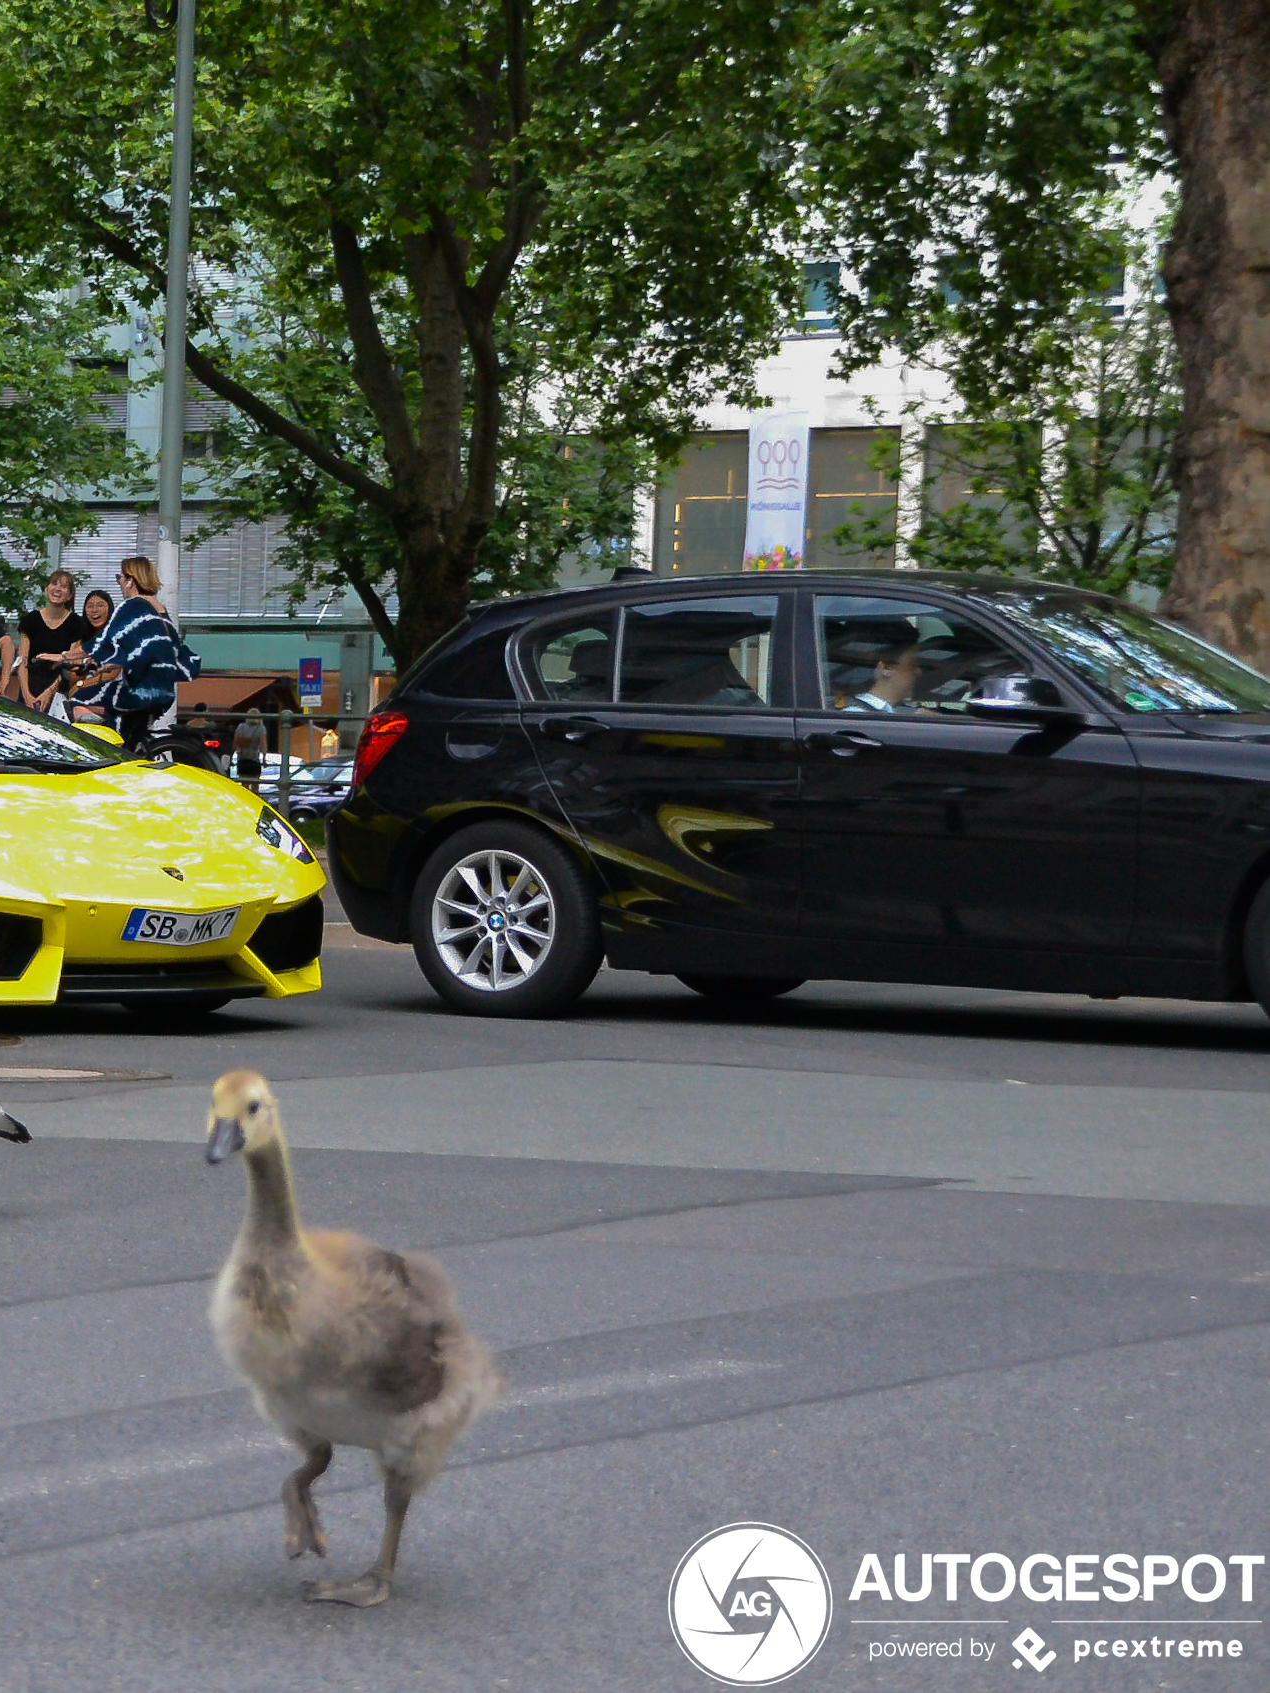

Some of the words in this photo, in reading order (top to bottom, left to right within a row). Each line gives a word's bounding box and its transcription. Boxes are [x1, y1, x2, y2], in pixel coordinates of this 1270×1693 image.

[300, 684, 321, 693] TAXI
[140, 915, 177, 939] SB
[189, 915, 220, 941] MK
[220, 912, 235, 935] 7
